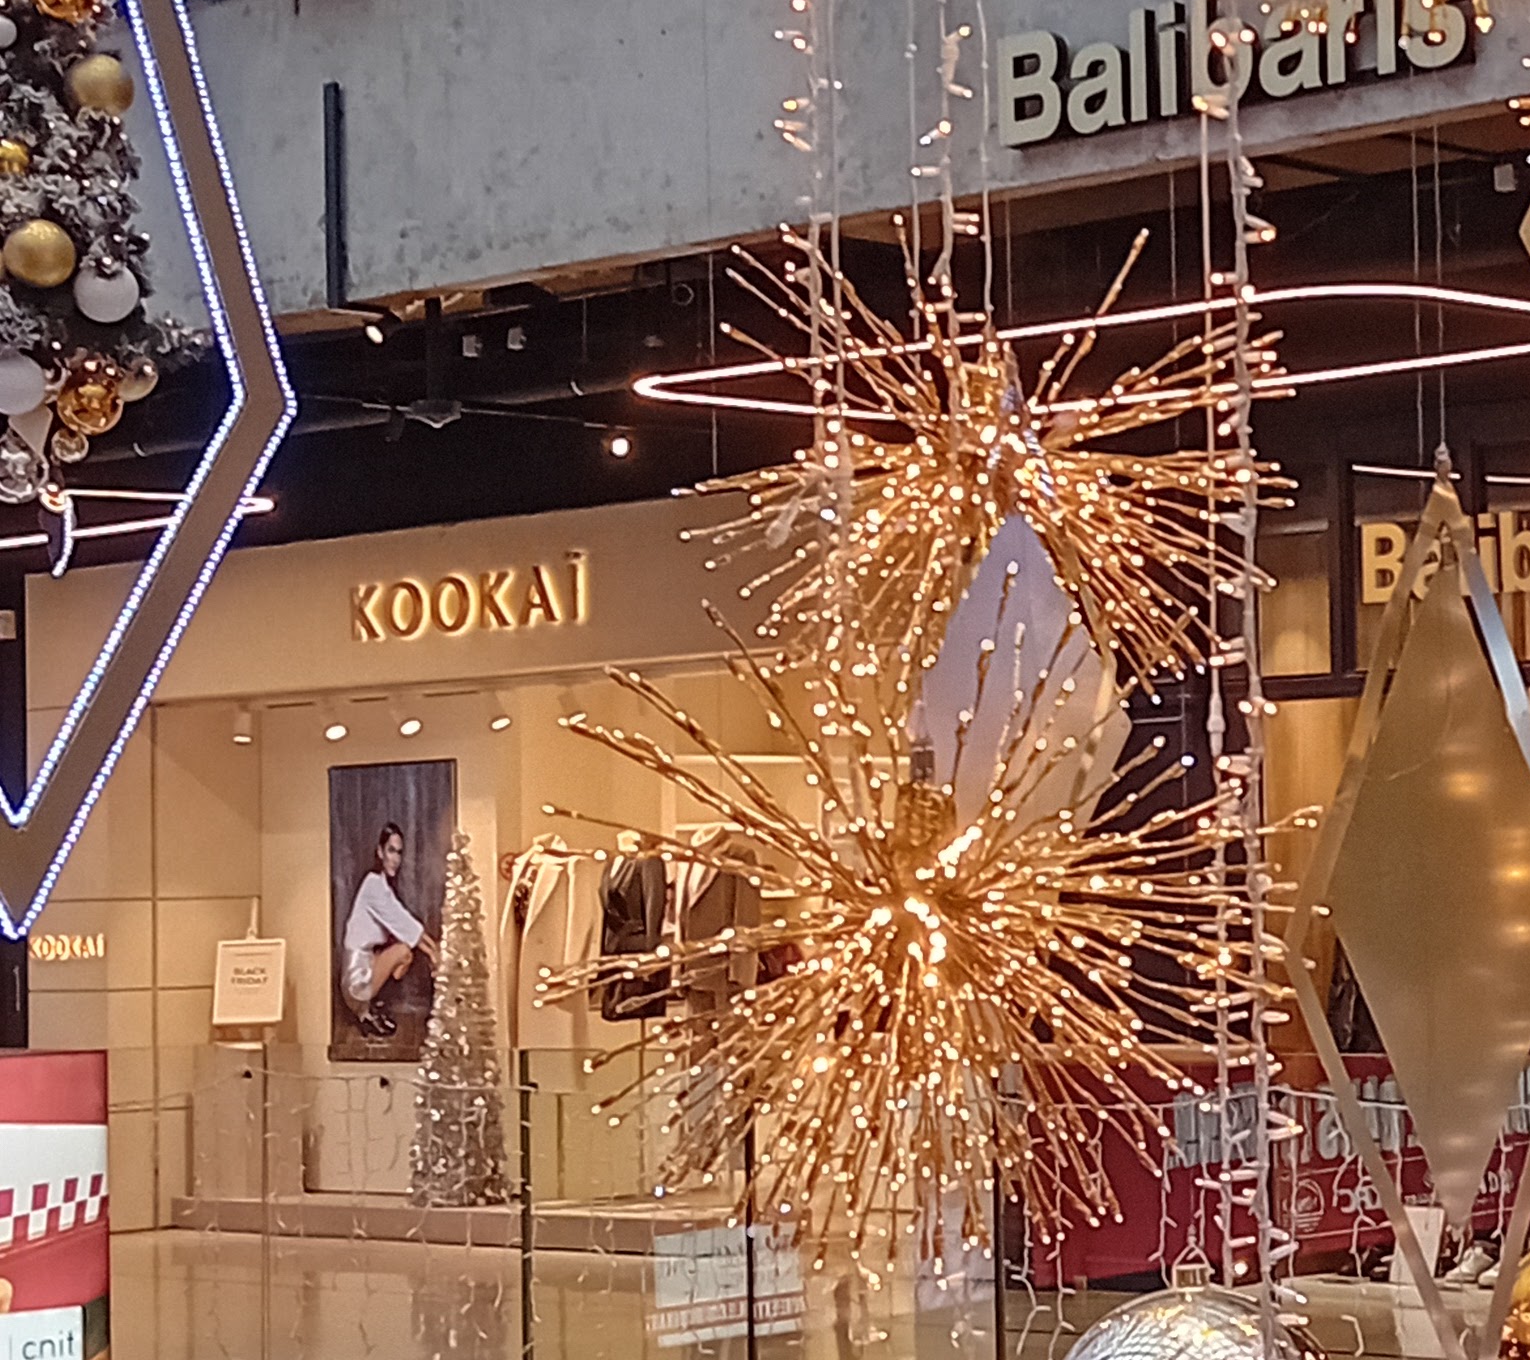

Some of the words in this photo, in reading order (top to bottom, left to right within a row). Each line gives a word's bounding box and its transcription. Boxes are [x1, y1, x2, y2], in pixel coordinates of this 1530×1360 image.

[233, 966, 266, 976] BLACK
[231, 976, 268, 985] FRIDAY
[22, 1330, 74, 1360] cnit
